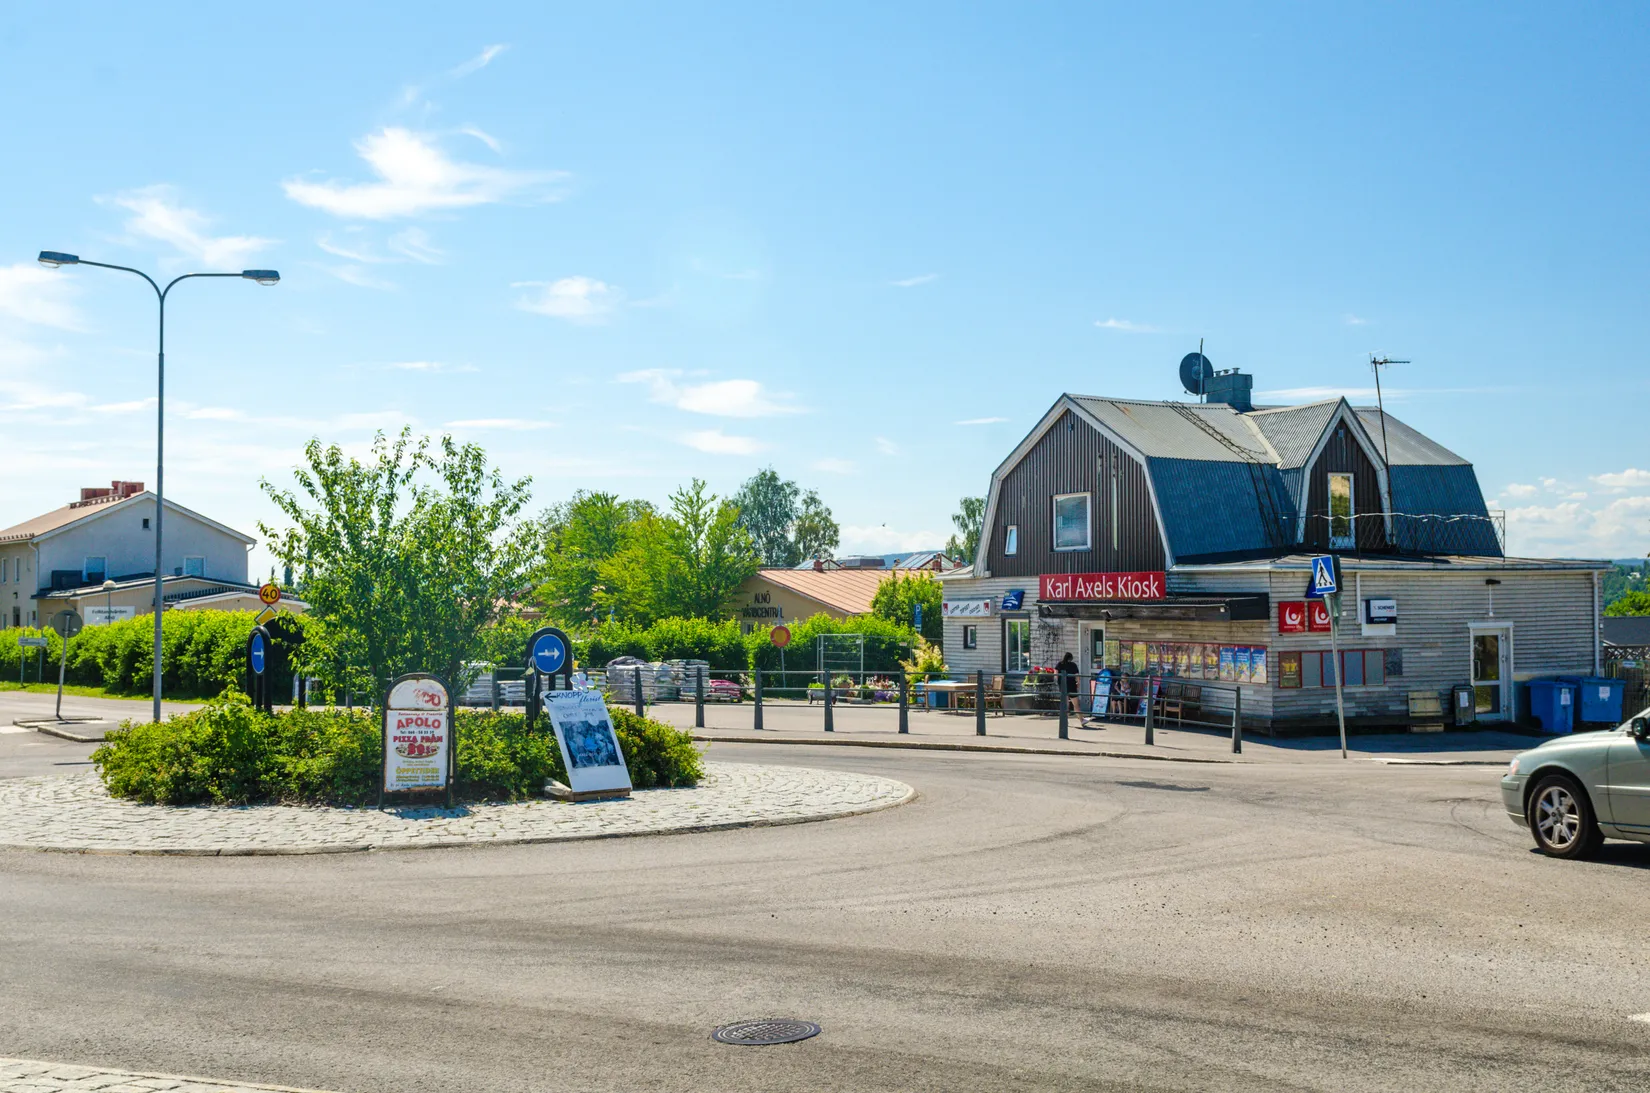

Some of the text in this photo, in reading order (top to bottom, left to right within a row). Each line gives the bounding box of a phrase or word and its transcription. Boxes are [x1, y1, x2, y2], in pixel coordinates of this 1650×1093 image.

[1046, 574, 1160, 598] Karl Axels Kiosk
[262, 588, 278, 600] 40
[754, 590, 771, 604] ALNÖ
[915, 605, 921, 615] P
[556, 691, 582, 699] KNOPP
[396, 717, 441, 730] APOLO
[393, 734, 443, 743] PIZZA FRÅN
